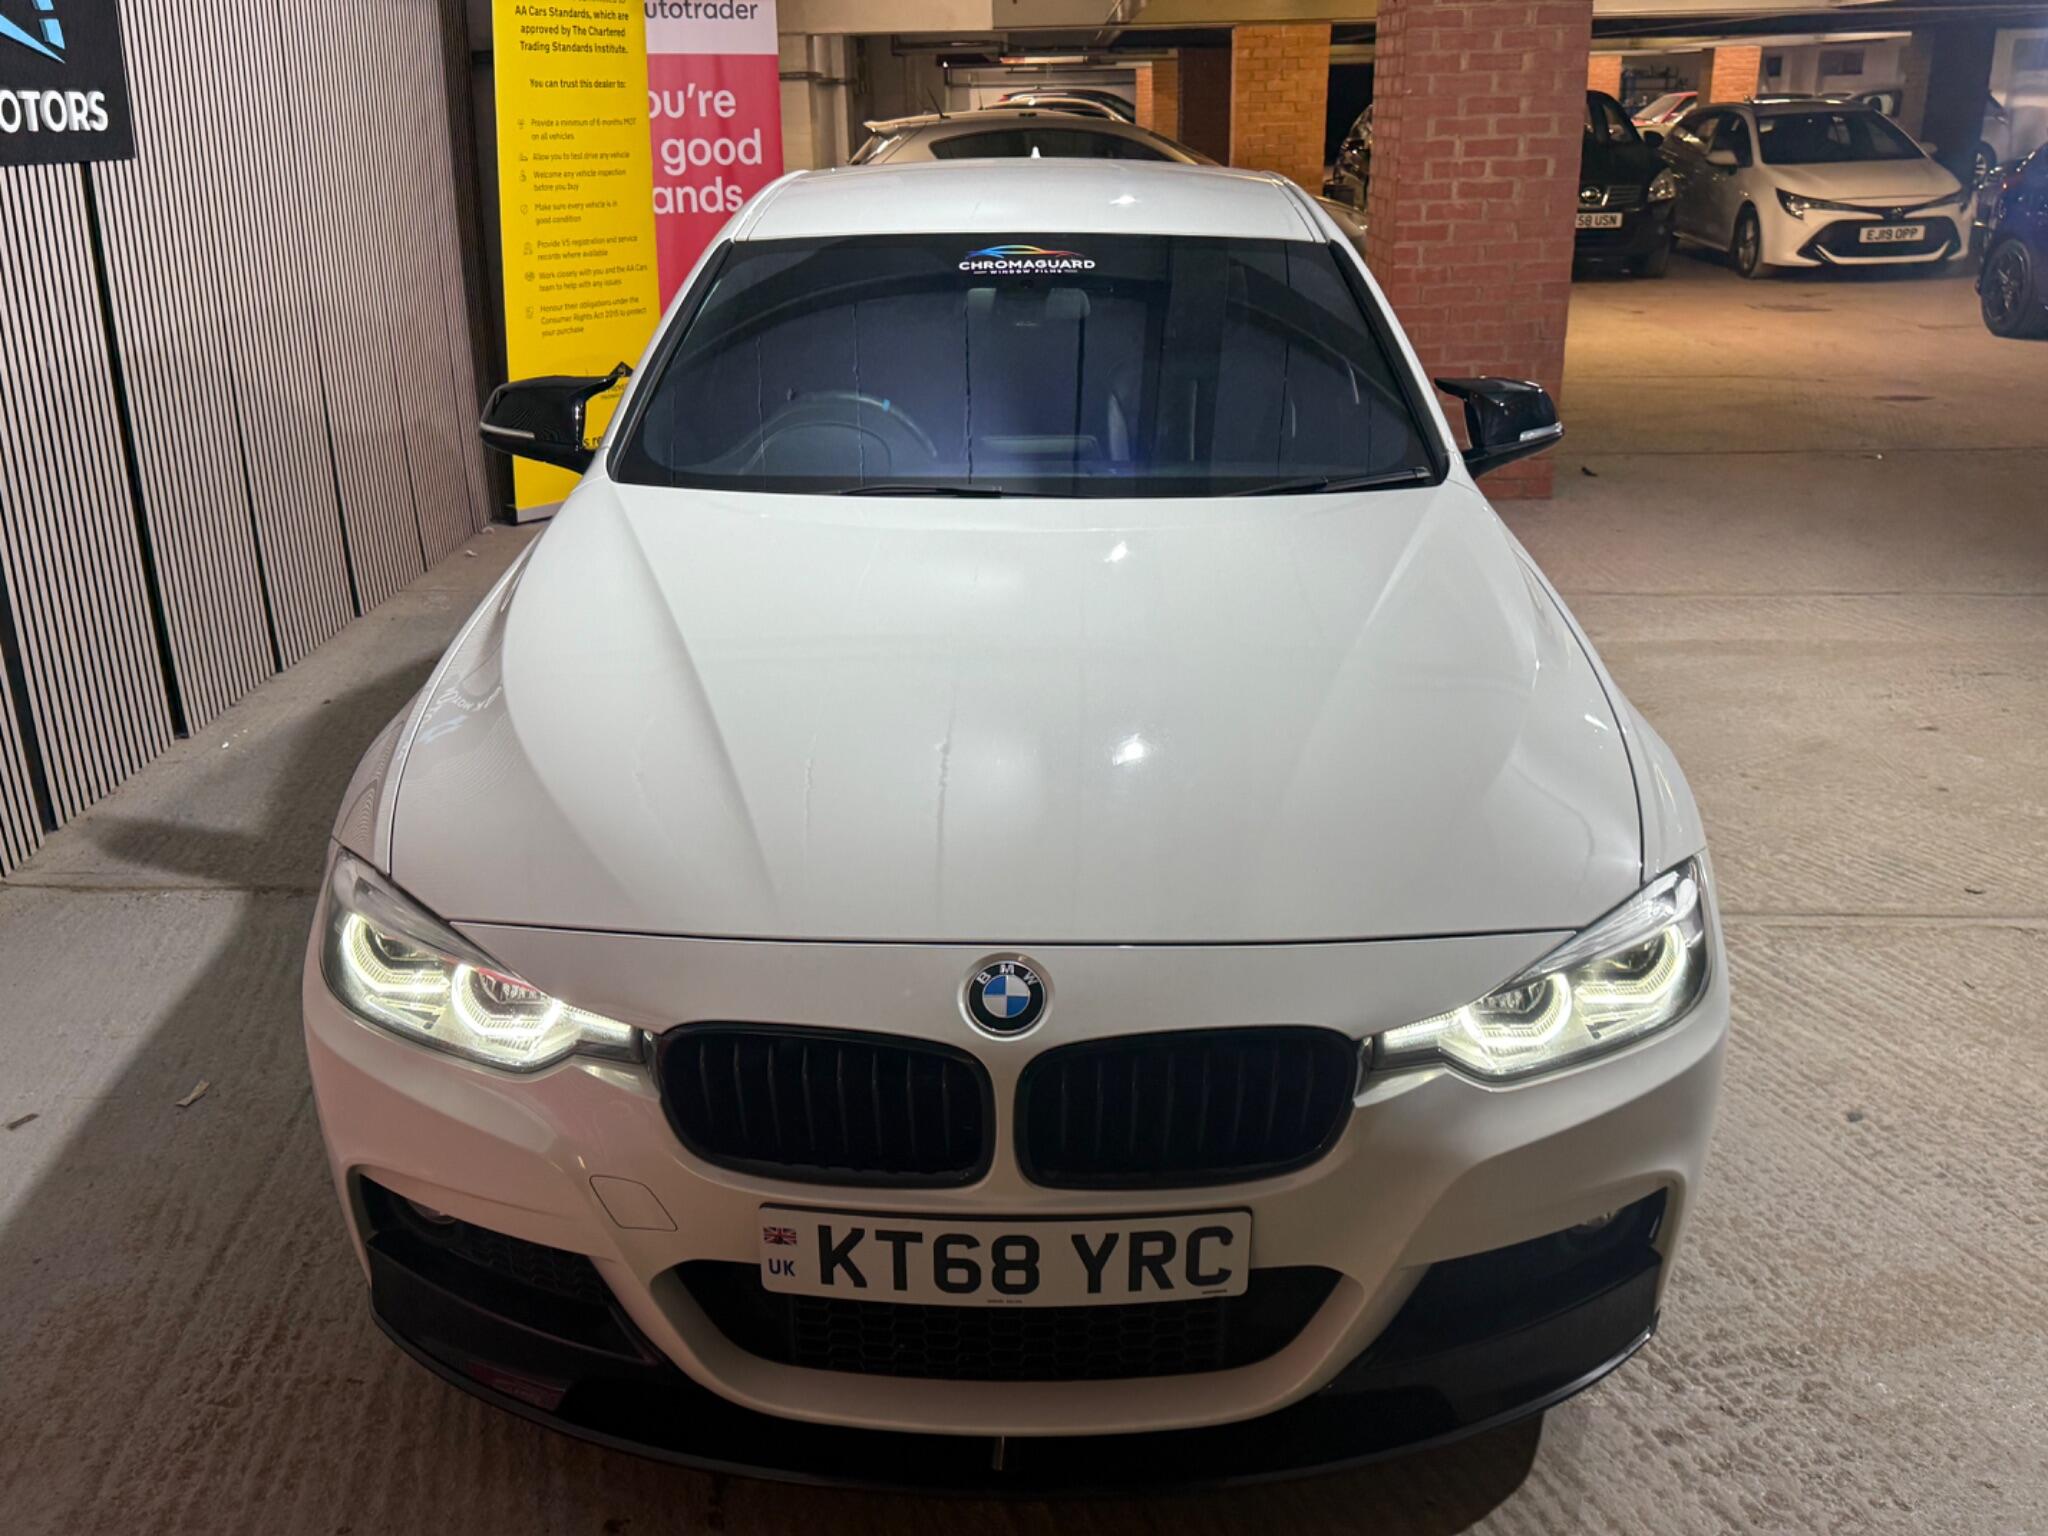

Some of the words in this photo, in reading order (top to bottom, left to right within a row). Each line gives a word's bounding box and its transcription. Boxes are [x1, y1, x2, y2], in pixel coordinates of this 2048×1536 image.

[514, 5, 527, 16] AA
[528, 6, 547, 16] Cars
[549, 7, 592, 19] Standards,
[593, 10, 617, 20] which
[618, 12, 629, 21] are
[644, 0, 758, 19] utotrader
[520, 25, 559, 35] approved
[561, 25, 571, 36] by
[572, 25, 587, 36] The
[588, 26, 626, 37] Chartered
[520, 41, 550, 53] Trading
[552, 41, 593, 53] Standards
[594, 43, 629, 54] Institute.
[529, 79, 543, 88] You
[545, 80, 559, 88] can
[560, 79, 578, 88] trust
[580, 79, 593, 88] this
[593, 79, 616, 89] dealer
[648, 83, 736, 118] ou're
[0, 89, 109, 134] OTORS
[531, 119, 554, 127] Provide
[561, 119, 588, 127] minimum
[602, 118, 623, 126] months
[623, 117, 637, 125] MOT
[531, 133, 540, 141] on
[549, 132, 575, 141] vehicles
[533, 152, 549, 160] Allow
[550, 153, 562, 162] you
[563, 152, 570, 160] to
[571, 152, 583, 160] test
[584, 151, 598, 160] drive
[599, 153, 609, 161] any
[610, 151, 630, 159] vehicle
[661, 128, 762, 176] good
[533, 170, 562, 179] Welcome
[563, 170, 574, 179] any
[576, 169, 597, 178] vehicle
[598, 169, 626, 177] inspection
[533, 183, 553, 192] before
[554, 183, 566, 192] you
[567, 183, 579, 192] buy
[652, 176, 743, 214] ands
[534, 203, 551, 211] Make
[553, 203, 566, 211] sure
[567, 202, 584, 211] every
[585, 201, 605, 209] vehicle
[536, 216, 551, 226] good
[552, 215, 581, 224] condition
[1578, 213, 1593, 227] 58
[1594, 213, 1618, 227] USN
[537, 240, 560, 249] Provide
[572, 238, 605, 247] registration
[606, 236, 617, 244] and
[618, 236, 638, 244] service
[537, 252, 561, 261] records
[563, 251, 581, 260] where
[958, 259, 1096, 270] CHROMAGUARD
[538, 271, 555, 280] Work
[556, 270, 577, 279] closely
[579, 268, 592, 276] with
[593, 268, 604, 277] you
[605, 266, 616, 275] and
[616, 265, 625, 273] the
[626, 264, 635, 272] AA
[635, 263, 648, 271] Cars
[538, 284, 555, 292] team
[556, 283, 562, 291] to
[563, 282, 577, 291] help
[578, 281, 592, 290] with
[592, 280, 603, 289] any
[603, 279, 623, 287] issues
[541, 303, 563, 312] Honour
[564, 302, 578, 311] their
[612, 297, 629, 306] under
[629, 296, 640, 304] the
[541, 315, 572, 325] Consumer
[573, 313, 593, 323] Rights
[593, 311, 604, 320] Act
[541, 329, 555, 339] your
[976, 963, 1040, 985] BMW
[817, 1223, 1041, 1295] KT68
[1071, 1225, 1235, 1295] YRC
[768, 1257, 796, 1278] UK
